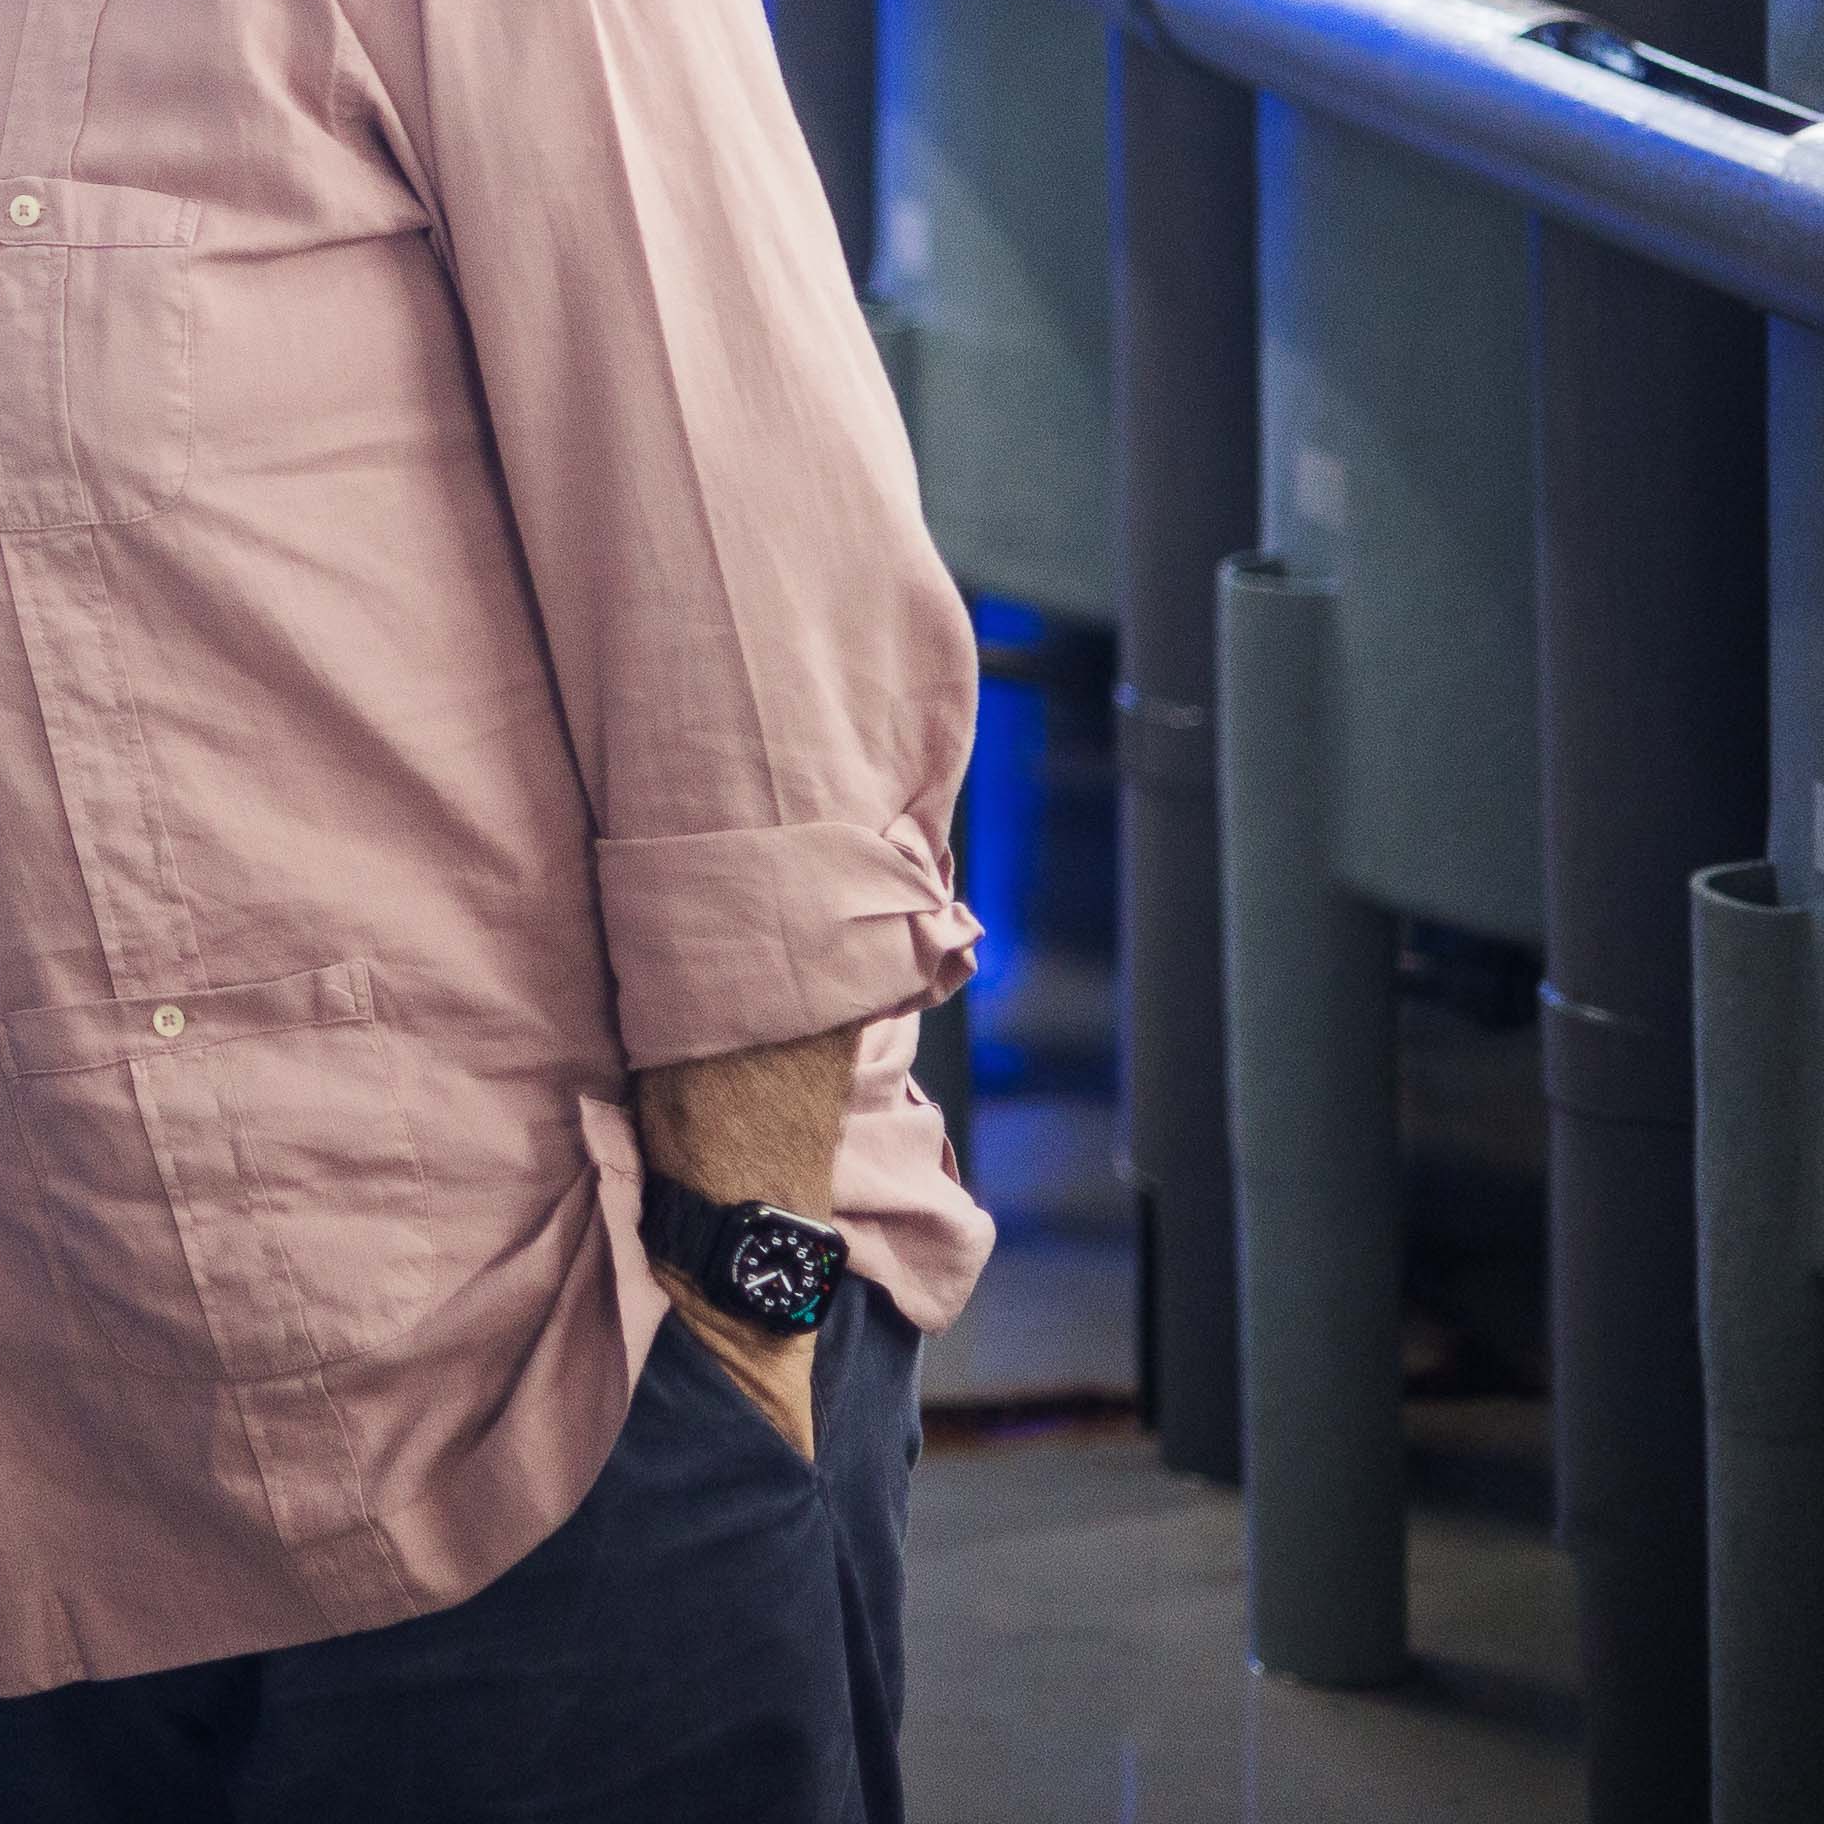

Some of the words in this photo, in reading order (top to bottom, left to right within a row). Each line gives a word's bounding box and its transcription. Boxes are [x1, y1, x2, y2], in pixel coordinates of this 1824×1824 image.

[787, 1237, 797, 1245] 9
[759, 1245, 769, 1254] 7
[796, 1248, 808, 1259] 10
[803, 1261, 814, 1271] 11
[802, 1276, 814, 1288] 12
[753, 1288, 763, 1296] 4
[765, 1298, 774, 1306] 3
